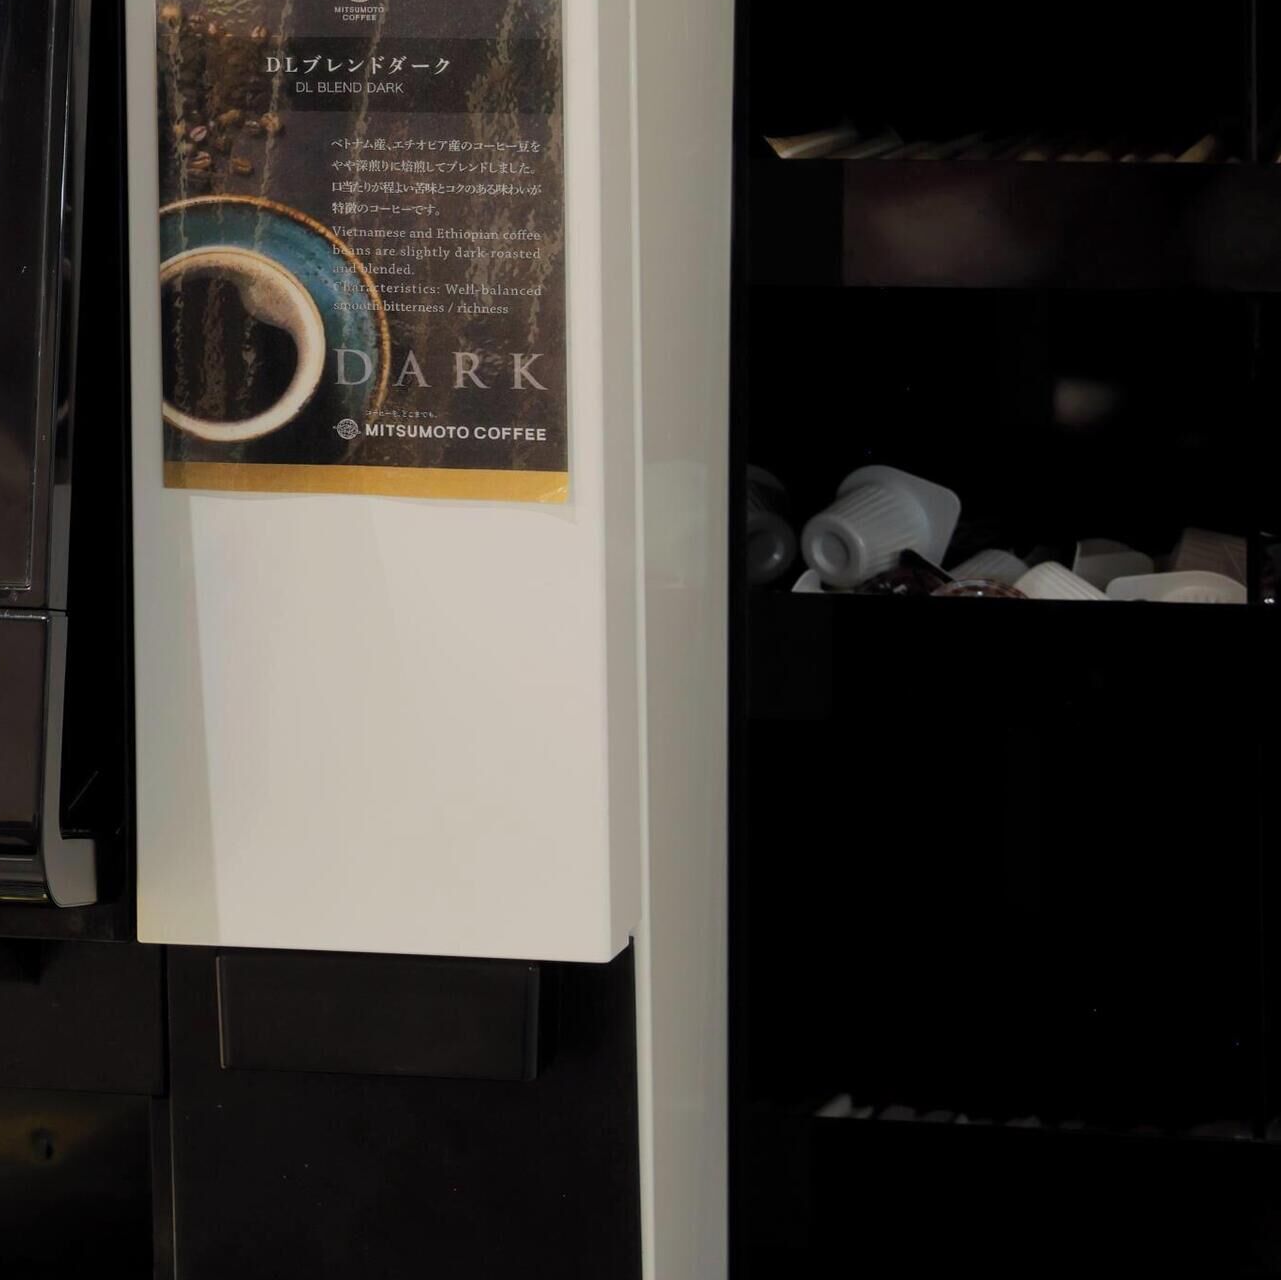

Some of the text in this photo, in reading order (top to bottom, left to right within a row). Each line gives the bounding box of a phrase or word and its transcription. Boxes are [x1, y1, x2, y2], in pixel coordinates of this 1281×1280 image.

[266, 55, 450, 75] DLブレンドダーク
[296, 82, 403, 93] DL BLEND DARK
[331, 139, 540, 153] ベトナム産、エチオピア産のコーヒー豆を
[331, 160, 536, 174] やや深煎りに焙煎してブレンドしました。
[332, 182, 542, 196] 口当たりが程よい苦味とコクのある味わいが
[332, 202, 440, 216] 特徴のコーヒーです。
[333, 226, 541, 241] Vietnamese and Ethiopian coffee
[333, 246, 540, 260] beans are slightly dark-roasted
[333, 264, 414, 275] and blended.
[334, 282, 542, 295] Characteristics: Well-balanced
[334, 301, 380, 311] smooth
[384, 301, 444, 313] bitterness
[457, 303, 508, 314] richness
[334, 348, 548, 390] DARK
[366, 425, 546, 440] MITSUMOTO COFFEE
